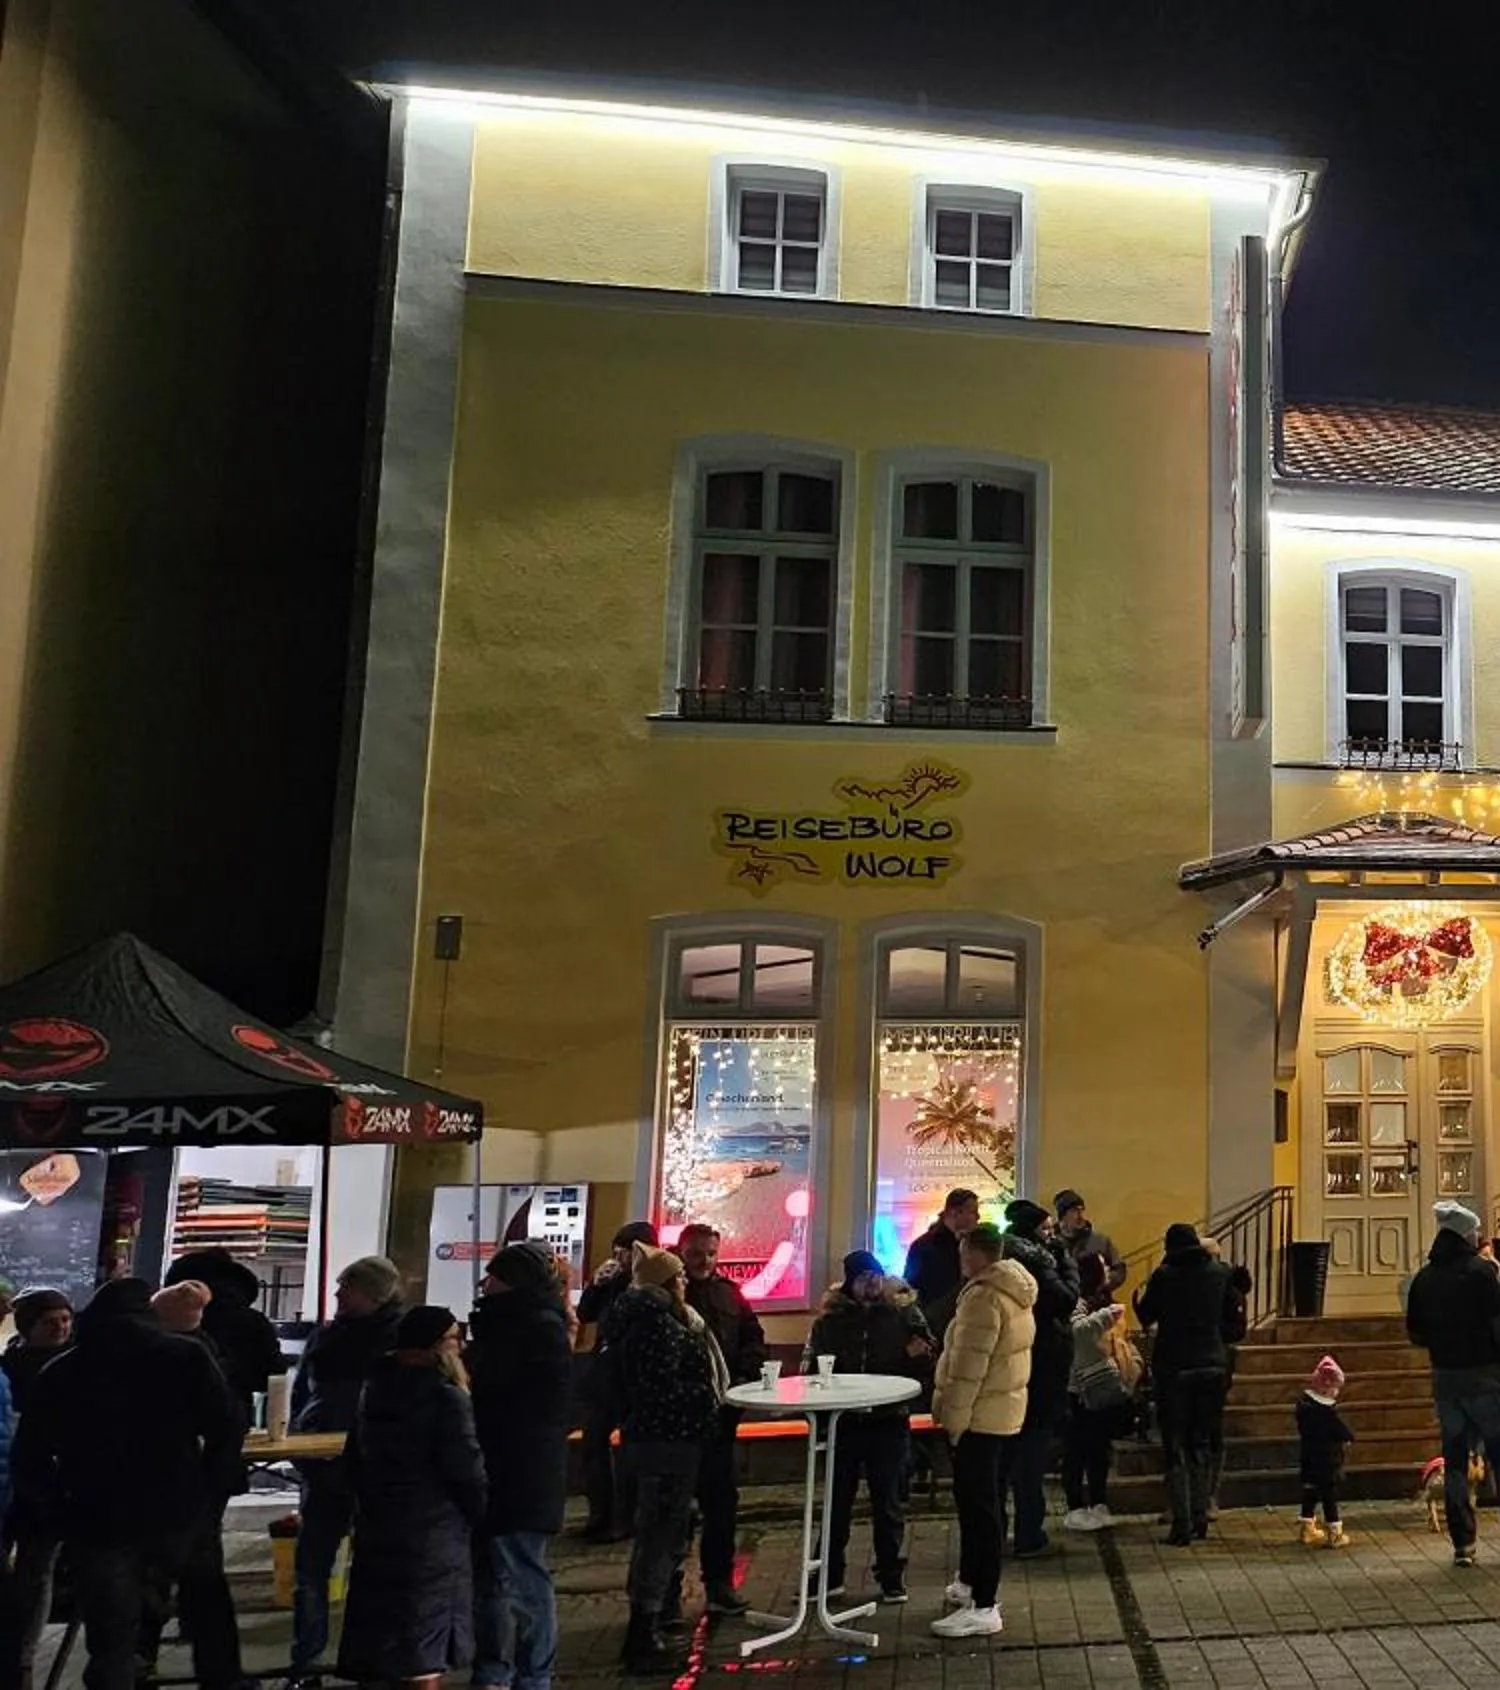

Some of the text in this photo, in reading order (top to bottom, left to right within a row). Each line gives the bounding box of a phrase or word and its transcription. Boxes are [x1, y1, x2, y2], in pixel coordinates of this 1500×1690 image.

[722, 803, 953, 842] REISEBÜRO
[845, 851, 950, 879] WOLF
[82, 1105, 277, 1134] 24MX
[362, 1107, 412, 1133] 24MX
